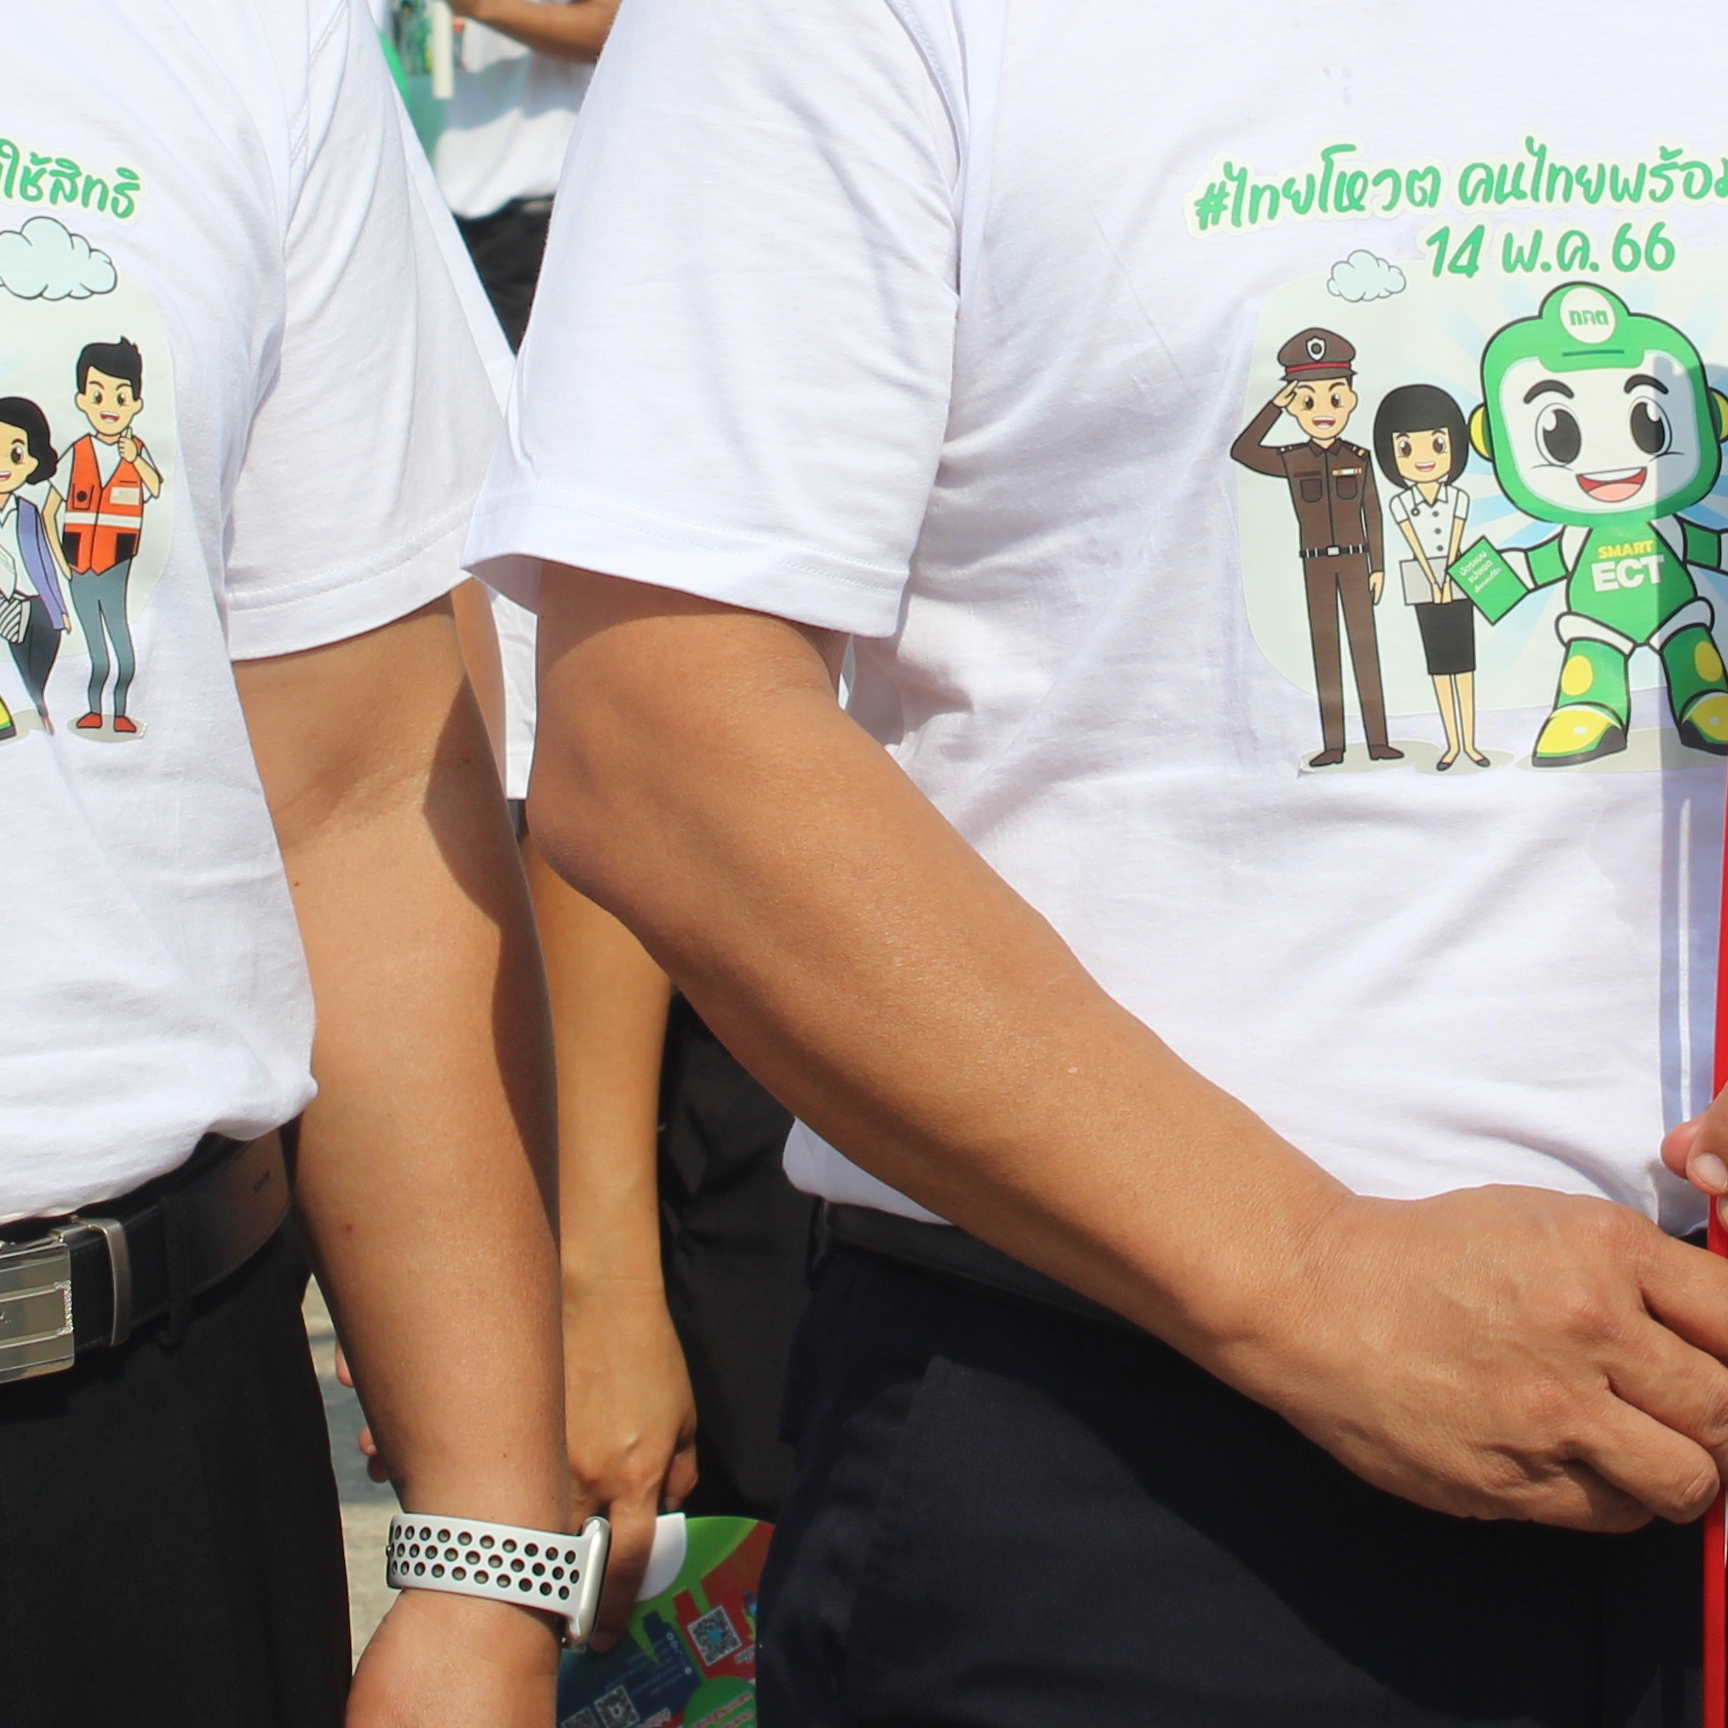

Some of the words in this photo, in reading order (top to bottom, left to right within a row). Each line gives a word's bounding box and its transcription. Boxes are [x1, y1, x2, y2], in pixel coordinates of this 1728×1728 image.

[1426, 224, 1488, 277] 14
[1502, 229, 1600, 273] พ.ค.
[1612, 222, 1676, 273] 66
[1597, 538, 1655, 561] SMART
[1591, 554, 1668, 594] ECT
